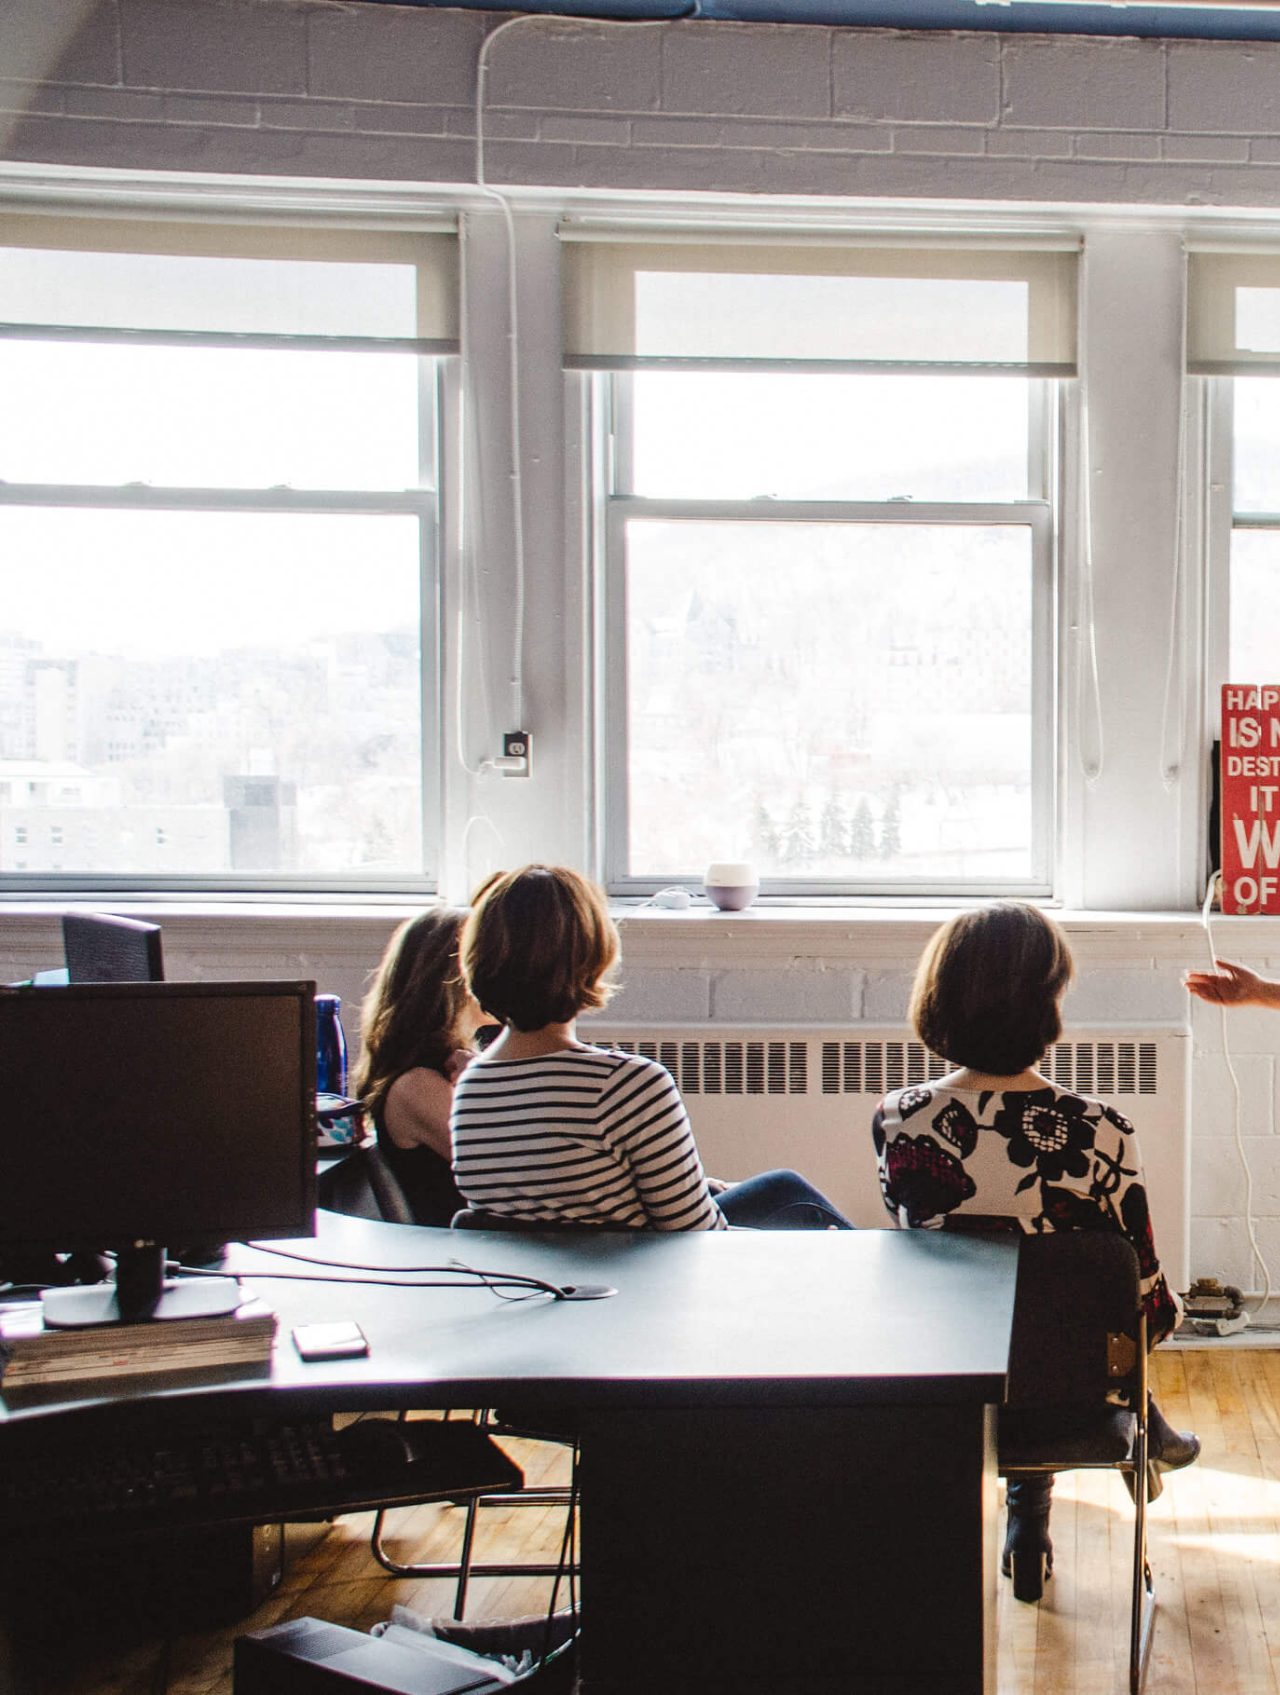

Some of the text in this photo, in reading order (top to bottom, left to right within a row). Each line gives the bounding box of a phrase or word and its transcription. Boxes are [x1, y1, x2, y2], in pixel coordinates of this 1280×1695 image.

[1229, 717, 1260, 748] IS
[1250, 786, 1279, 812] IT
[1233, 877, 1278, 905] OF
